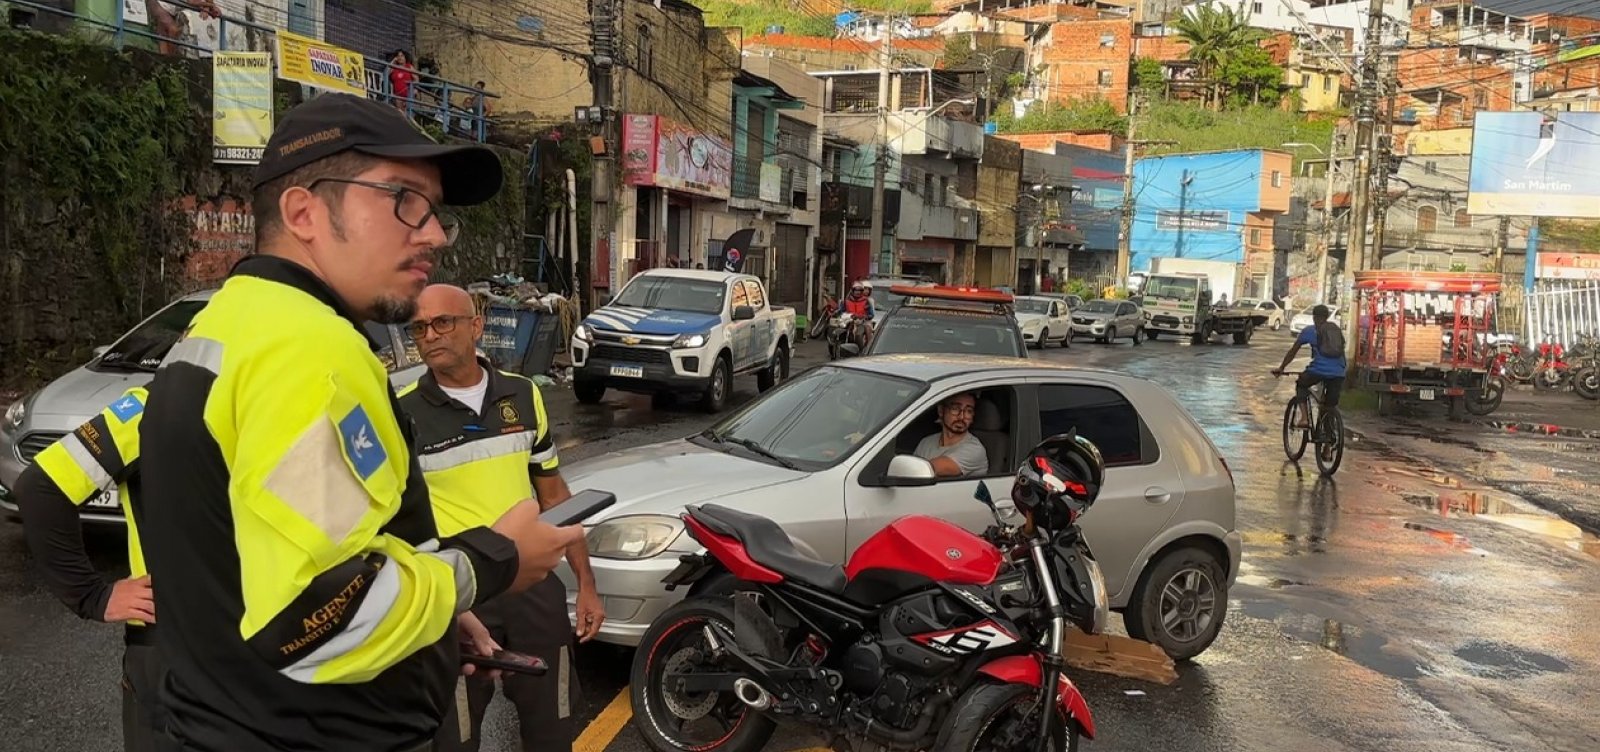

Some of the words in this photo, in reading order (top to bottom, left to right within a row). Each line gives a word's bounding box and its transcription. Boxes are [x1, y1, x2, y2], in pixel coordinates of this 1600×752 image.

[216, 57, 245, 67] SAPATARIA
[246, 57, 268, 68] INOVAR
[311, 59, 345, 78] INOVAR
[280, 128, 343, 156] TRANSALVADOR
[1504, 179, 1525, 189] San
[1528, 180, 1572, 191] Martim
[303, 574, 364, 633] AGENTE
